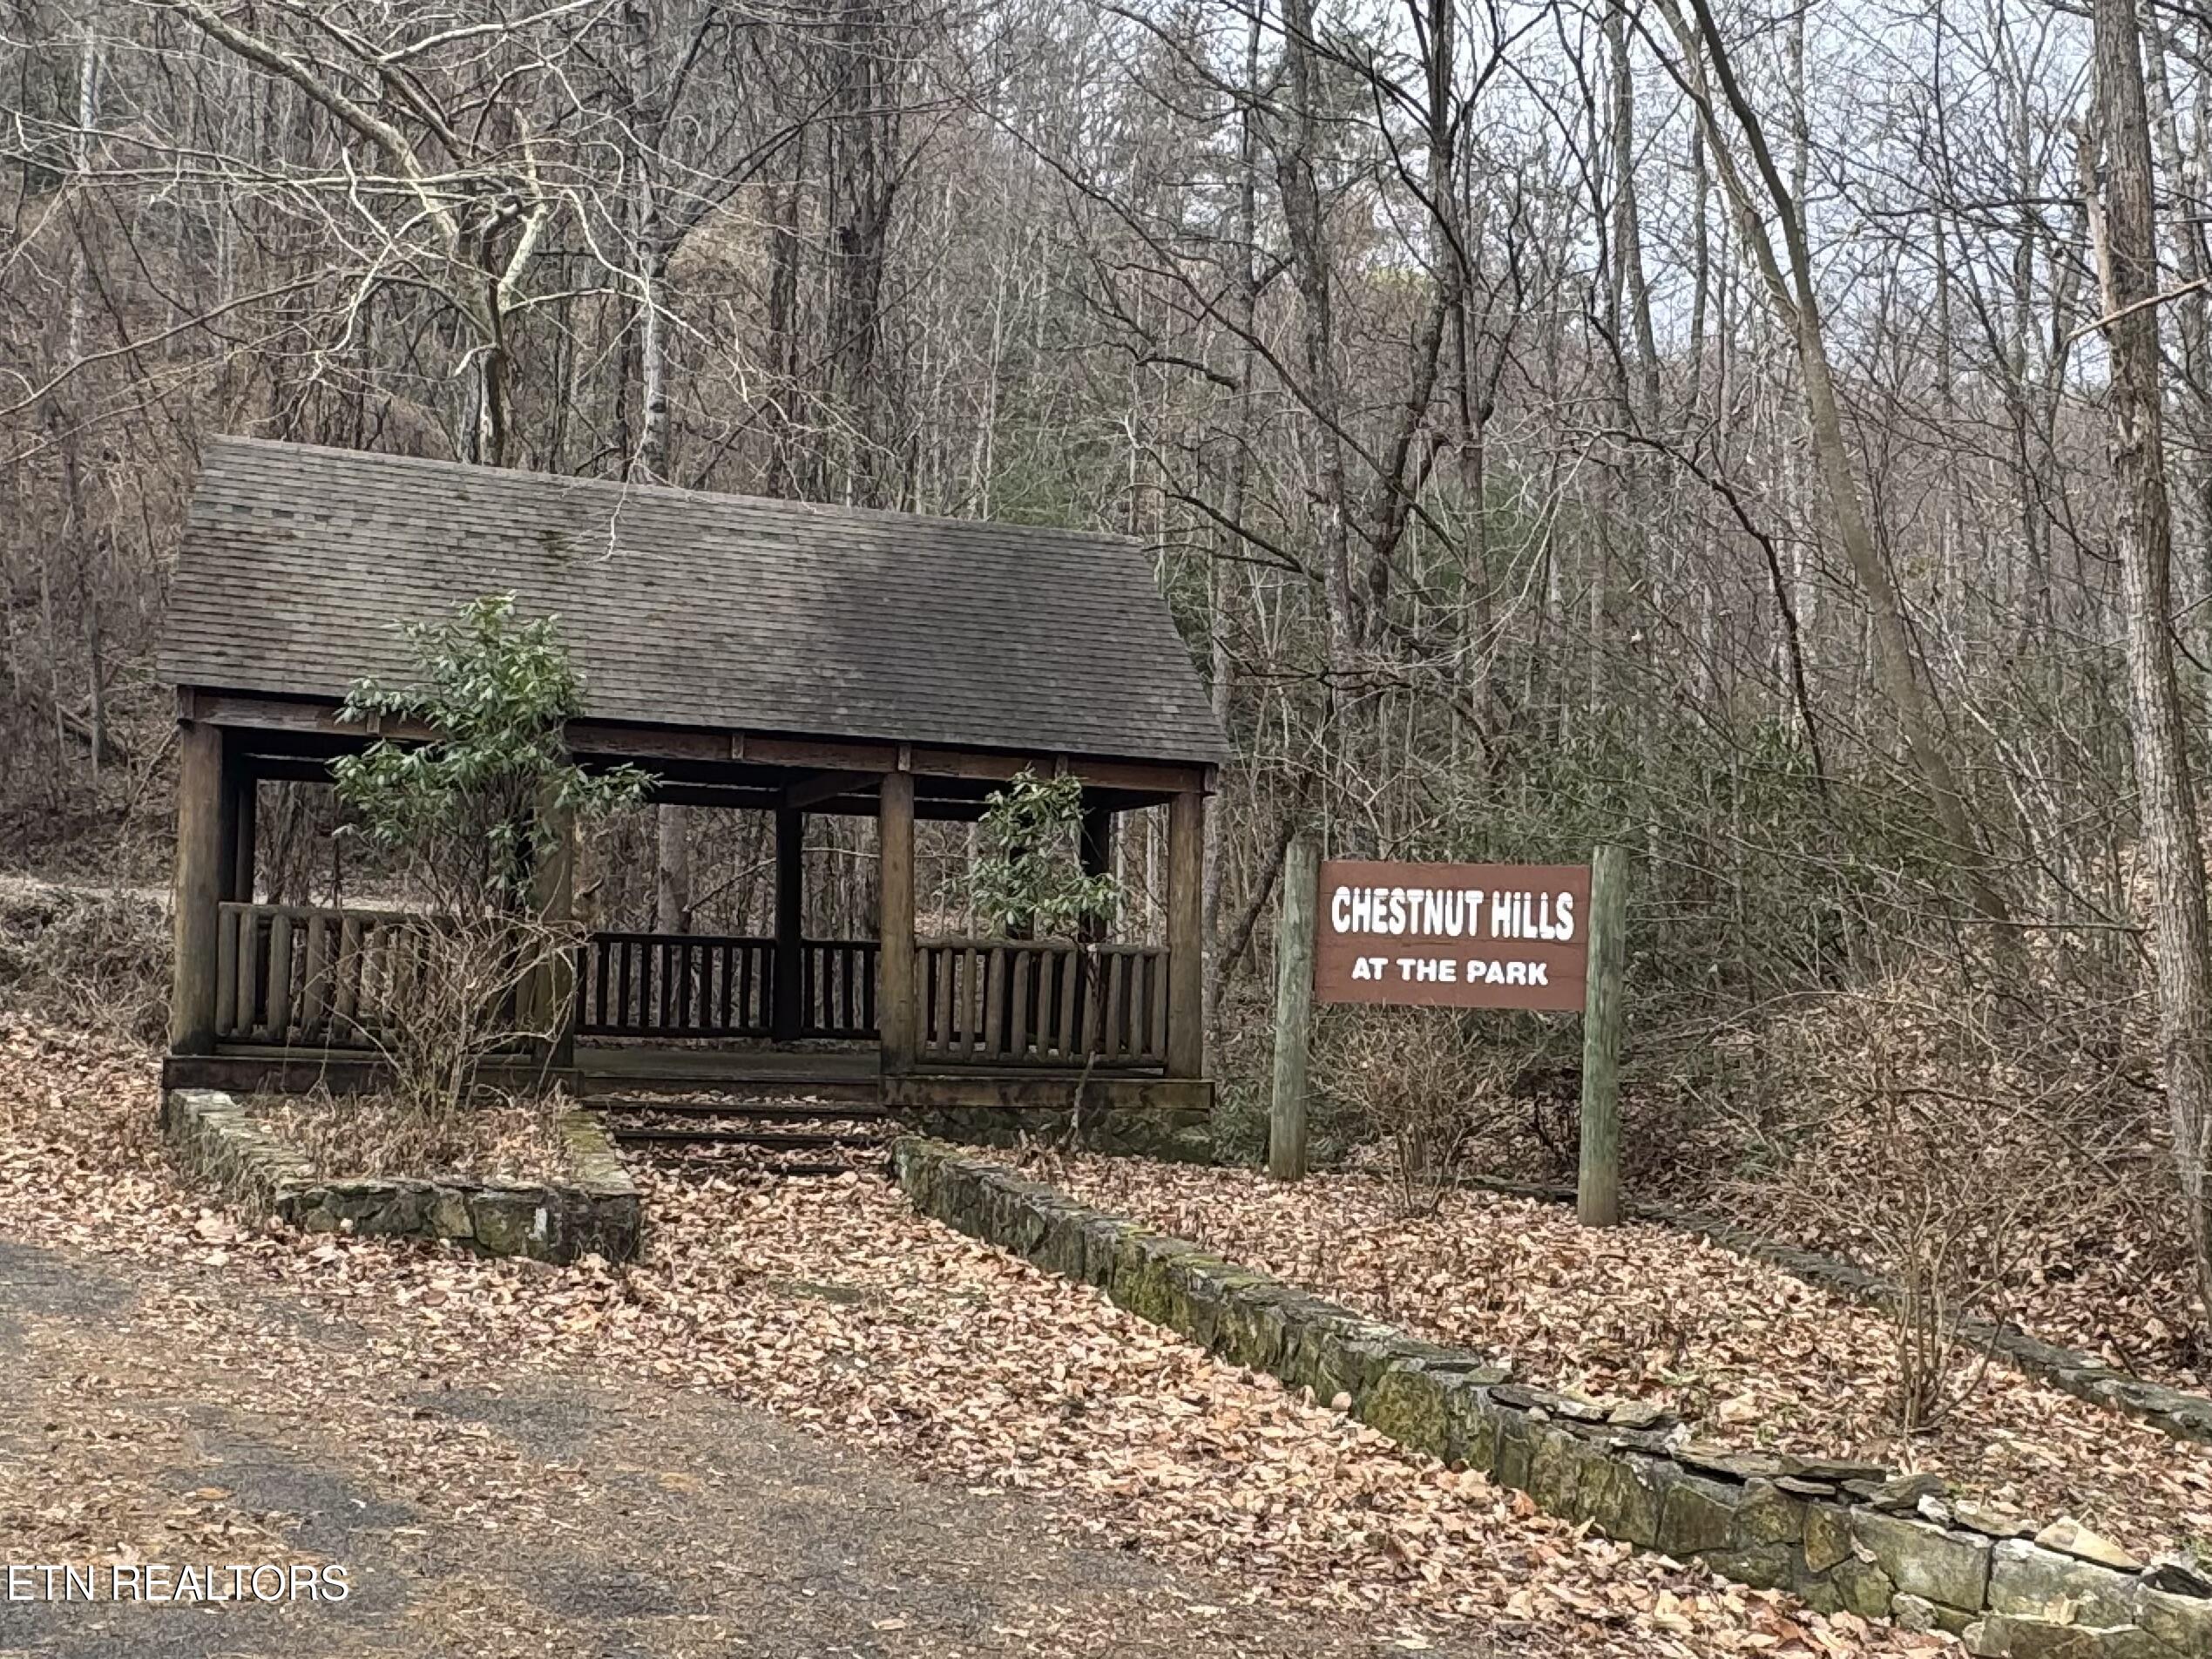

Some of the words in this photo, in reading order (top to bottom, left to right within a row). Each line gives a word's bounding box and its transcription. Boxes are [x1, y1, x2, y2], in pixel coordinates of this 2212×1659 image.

[1331, 886, 1484, 937] CHESTNUT
[1492, 890, 1574, 941] HILLS
[1351, 957, 1388, 980] AT
[1397, 958, 1457, 982] THE
[1466, 960, 1548, 985] PARK
